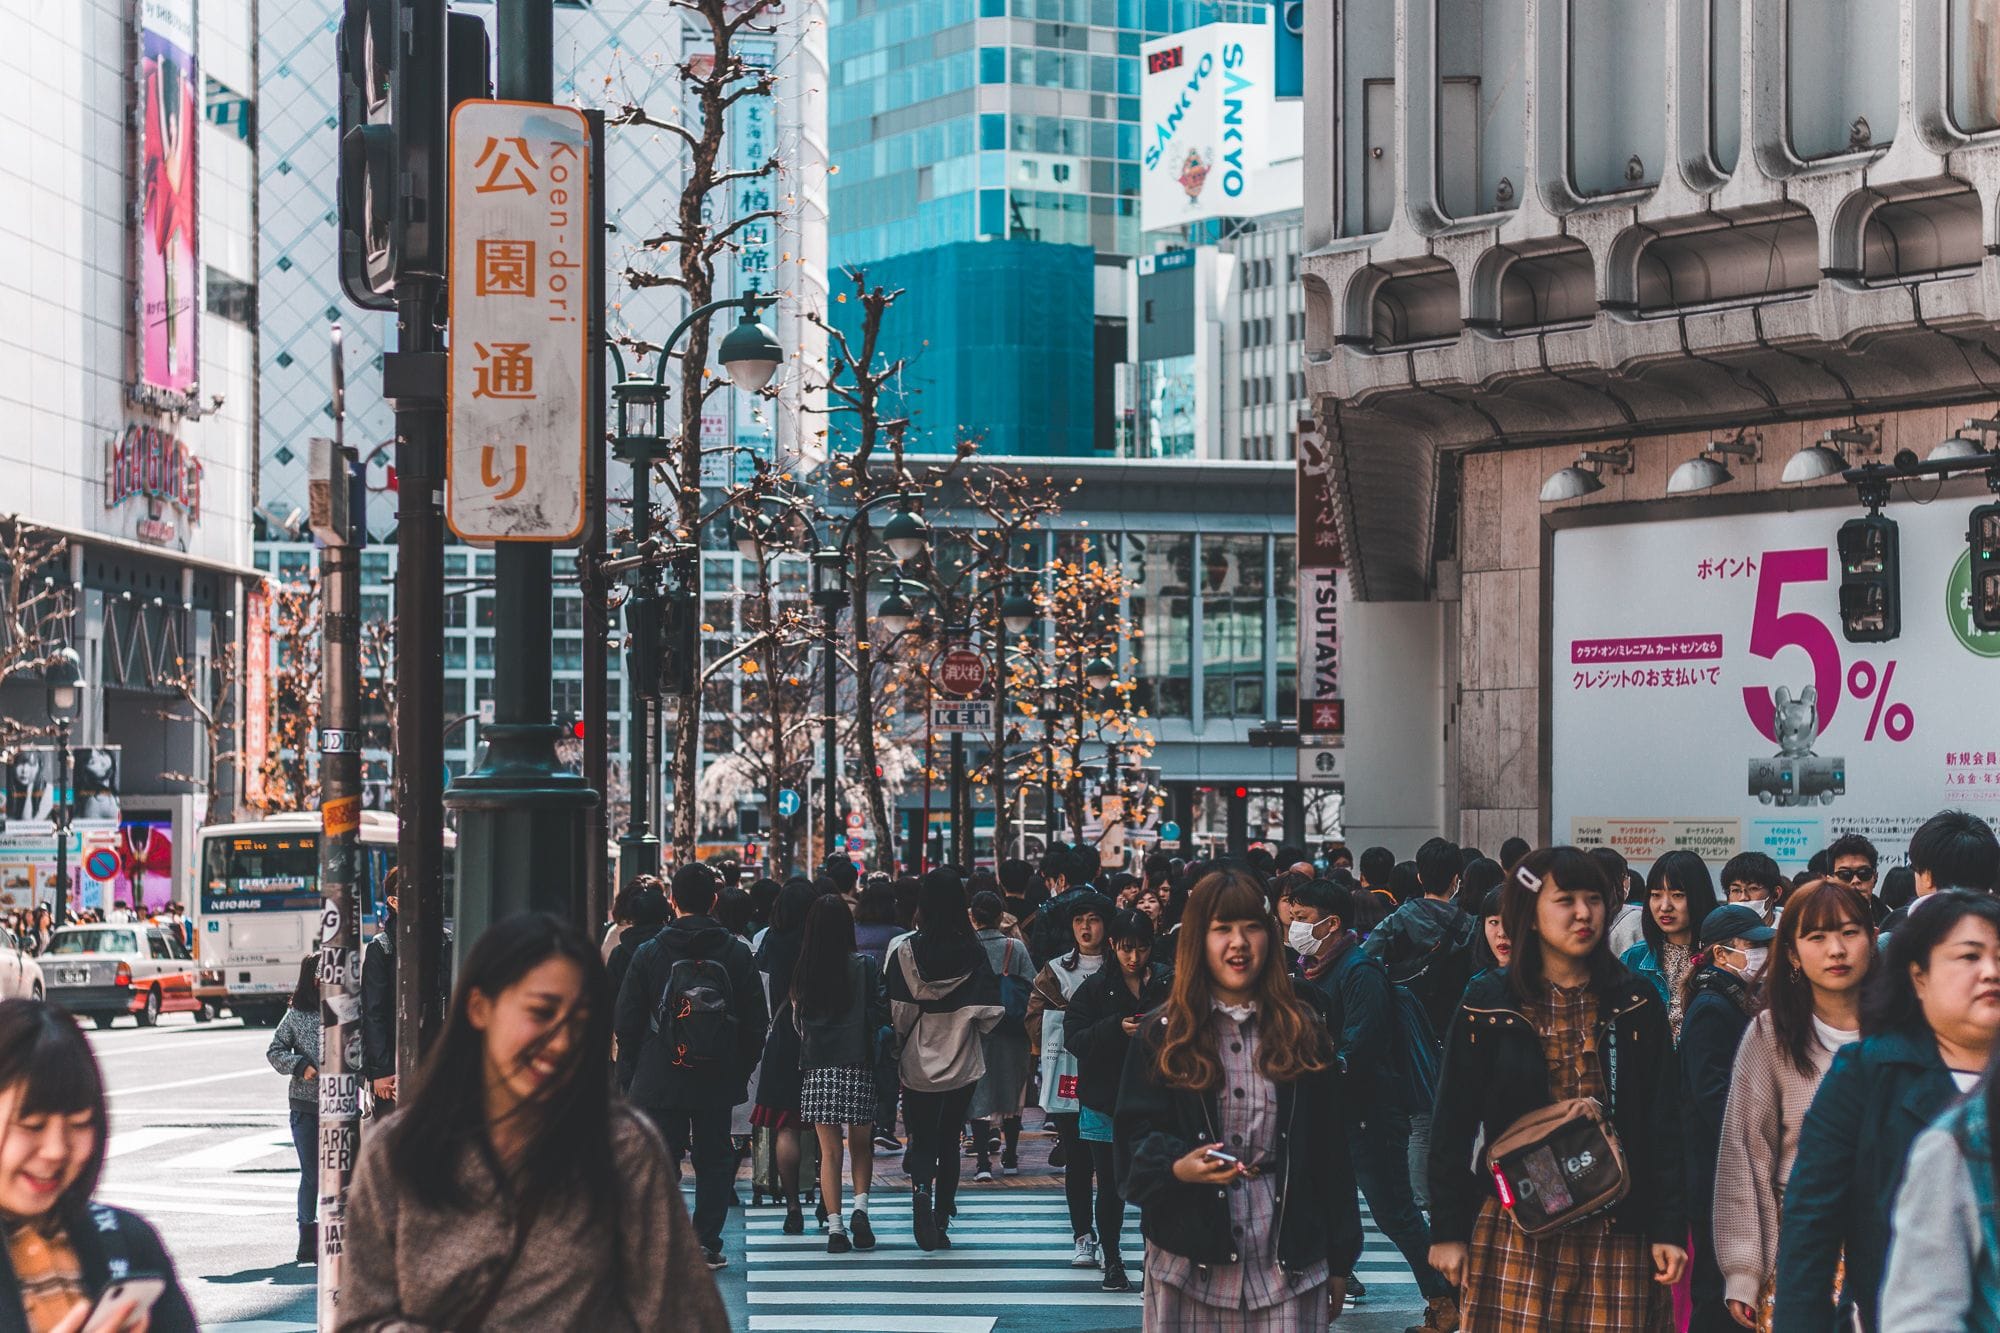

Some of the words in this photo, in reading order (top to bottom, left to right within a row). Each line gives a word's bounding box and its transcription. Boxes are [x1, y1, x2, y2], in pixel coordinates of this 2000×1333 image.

[1145, 52, 1214, 171] SANKYO
[1223, 42, 1254, 197] SANKYO
[548, 141, 580, 324] Koen-dori
[472, 136, 540, 500] 公園通り
[110, 424, 204, 527] MAGNET
[1697, 556, 1757, 580] ポイント
[1315, 569, 1337, 698] TSUTAYA
[945, 664, 981, 681] 消火栓
[1572, 666, 1722, 690] クレジットのお支払いで
[939, 711, 987, 724] KEN
[1625, 846, 1653, 855] プレゼント
[238, 899, 261, 909] BUS
